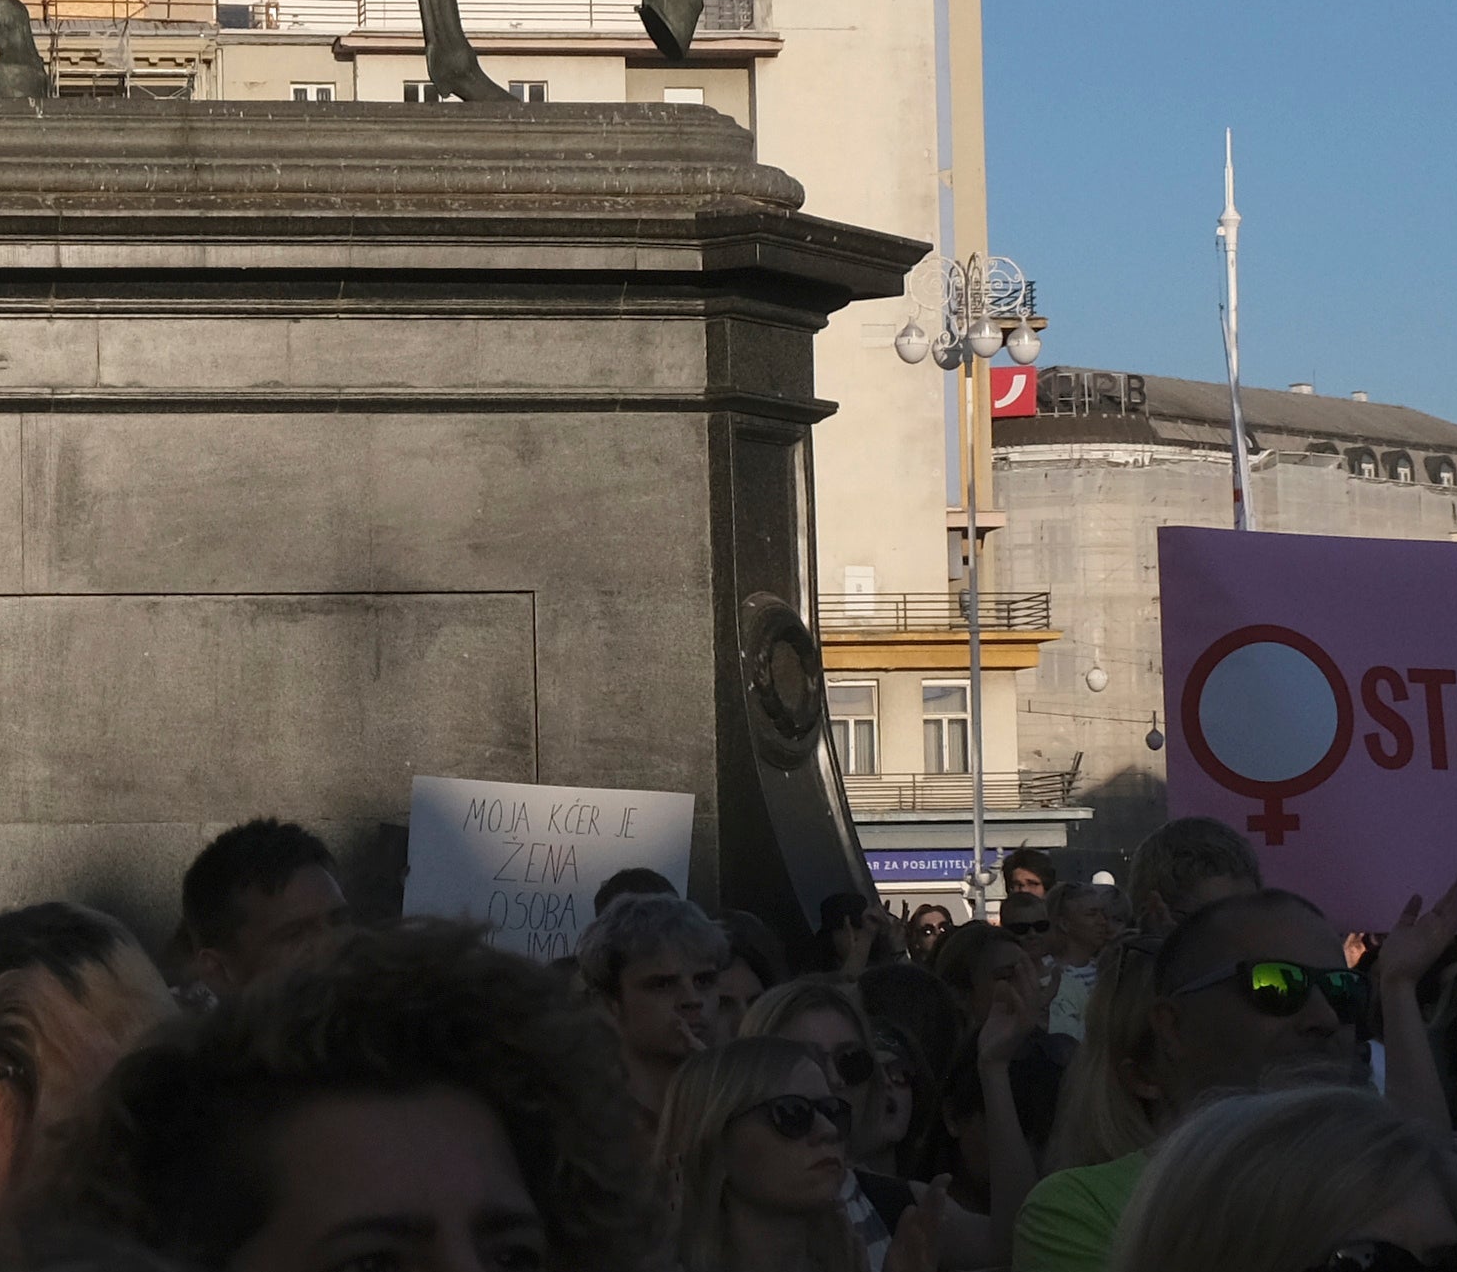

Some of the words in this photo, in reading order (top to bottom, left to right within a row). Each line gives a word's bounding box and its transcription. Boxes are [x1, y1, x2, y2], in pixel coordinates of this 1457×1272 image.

[462, 797, 531, 834] MOJA
[614, 806, 639, 839] JE
[492, 835, 580, 885] ŽENA
[884, 859, 899, 870] ZA
[902, 859, 975, 871] POSJETITELJ
[487, 890, 577, 933] OSOBA
[526, 931, 583, 961] IMOV
